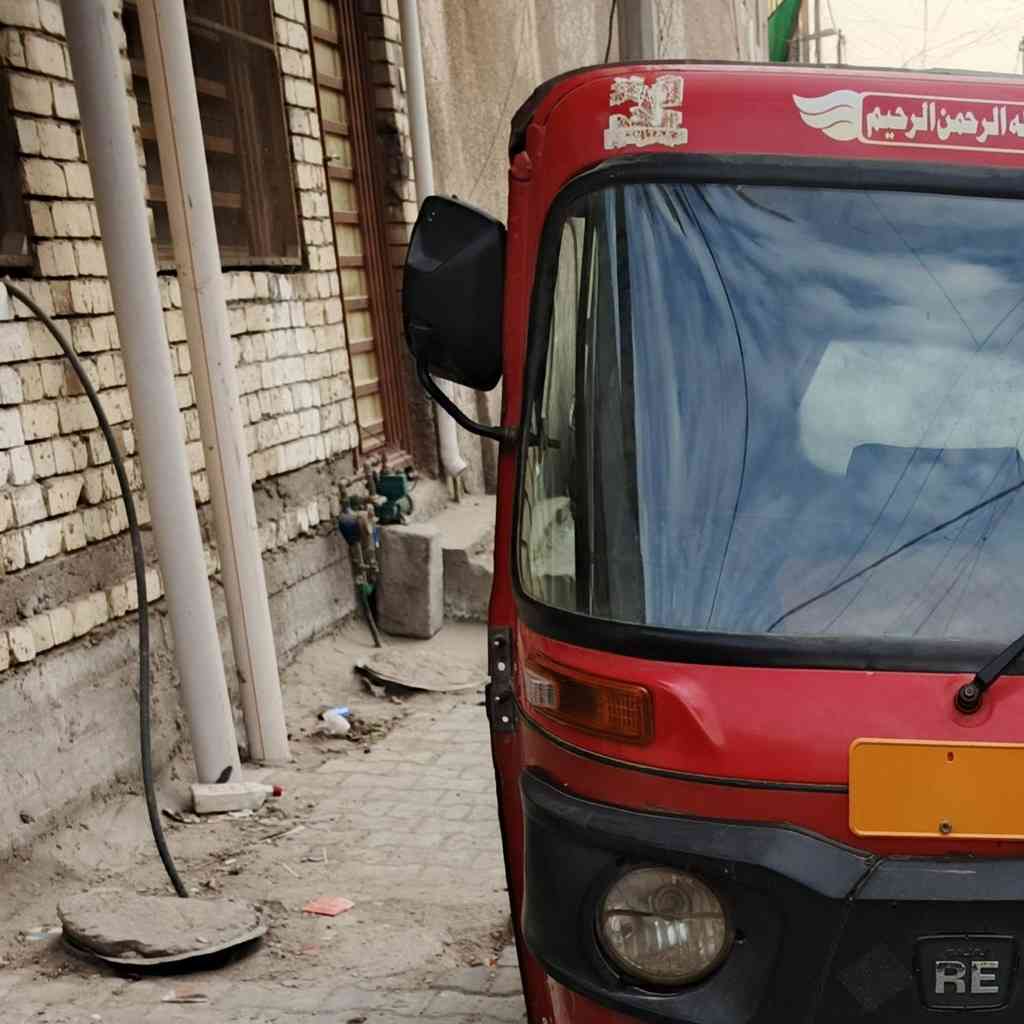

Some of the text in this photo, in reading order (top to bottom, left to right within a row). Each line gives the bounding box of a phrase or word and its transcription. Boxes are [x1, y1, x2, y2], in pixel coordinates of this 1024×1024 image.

[866, 101, 936, 139] الرحيم
[937, 105, 1007, 143] الرحمن
[935, 960, 999, 993] RE
